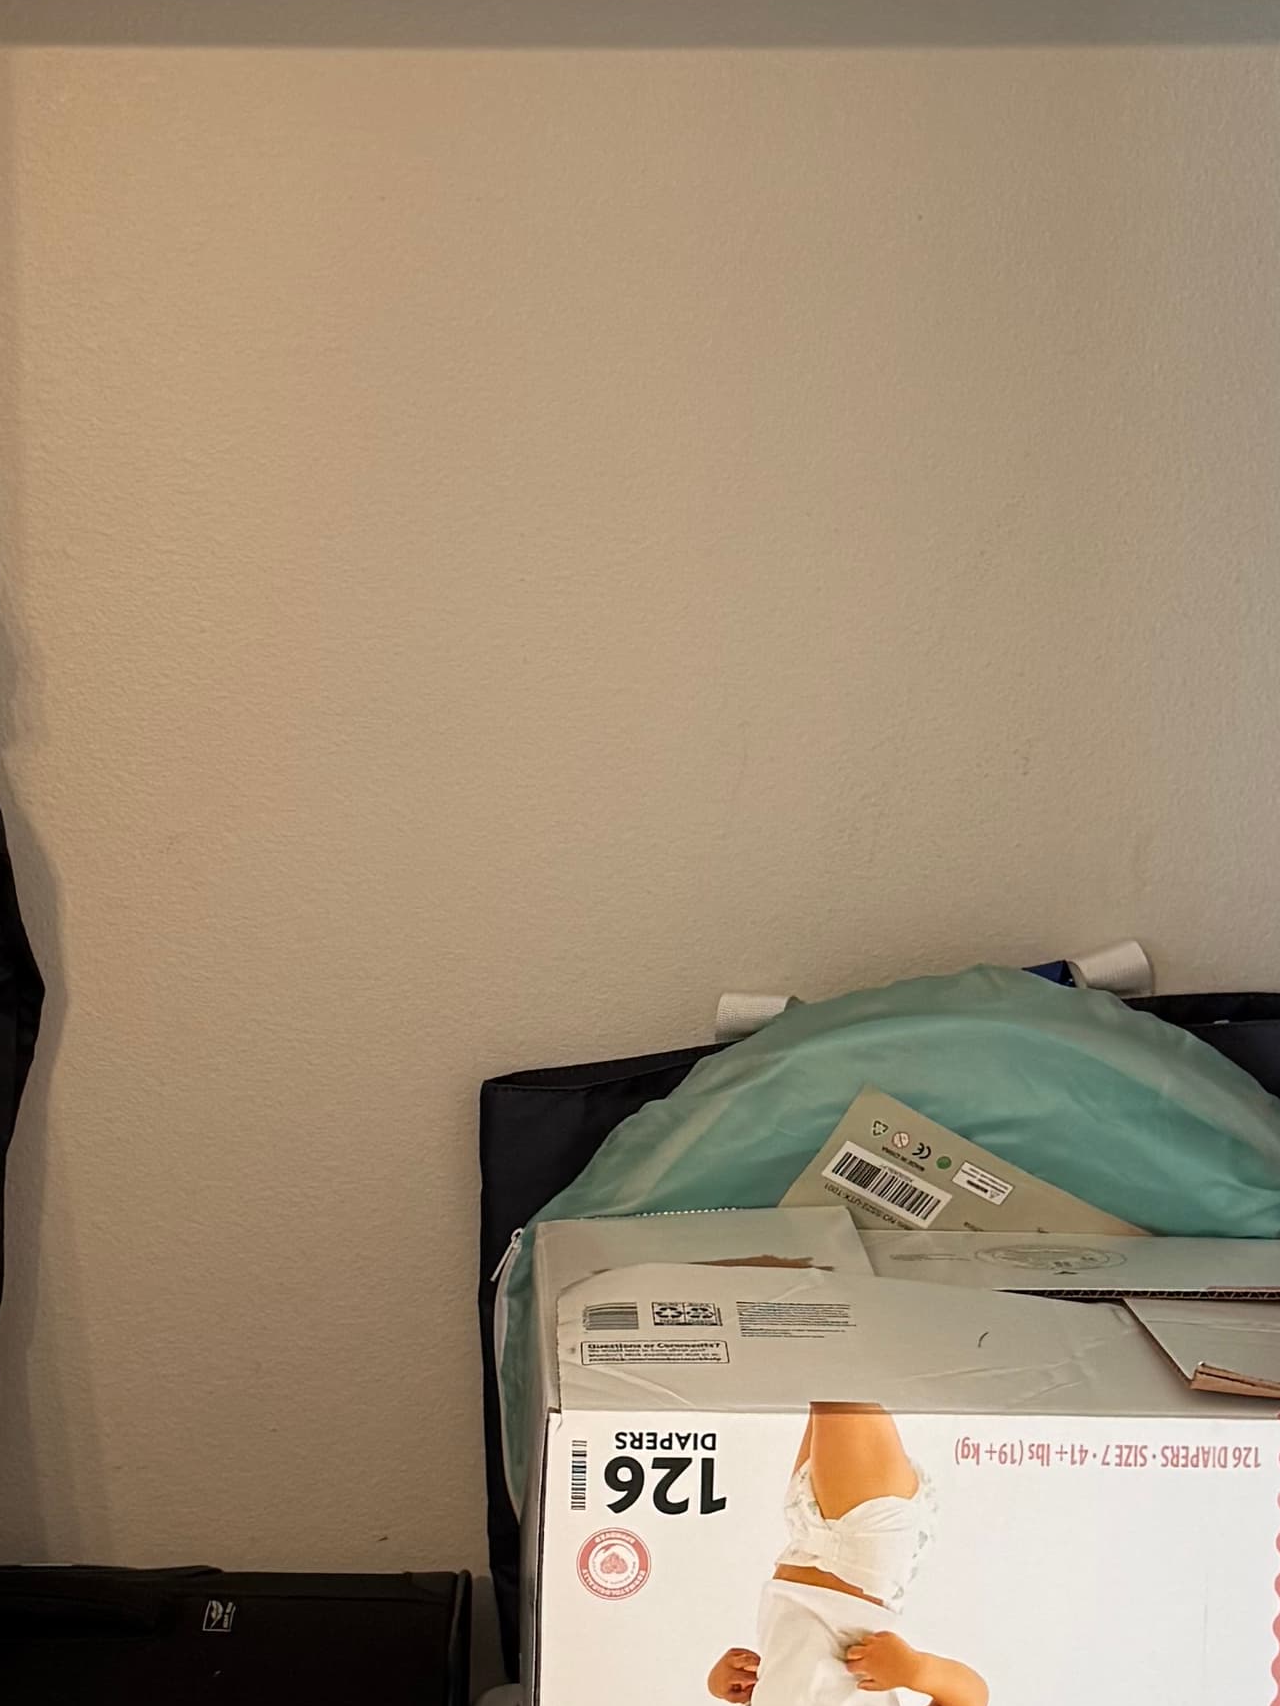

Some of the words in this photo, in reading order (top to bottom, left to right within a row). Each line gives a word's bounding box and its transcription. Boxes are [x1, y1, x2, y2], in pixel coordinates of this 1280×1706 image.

[614, 1431, 717, 1451] DIAPERS
[954, 1436, 981, 1465] kg)
[984, 1439, 1024, 1466] (19+
[1028, 1442, 1051, 1466] lbs
[1055, 1443, 1089, 1465] 41+
[1100, 1443, 1111, 1466] 7
[1114, 1443, 1148, 1467] SIZE
[1160, 1444, 1228, 1468] DIAPERS
[1233, 1446, 1262, 1468] 126
[603, 1455, 727, 1515] 126
